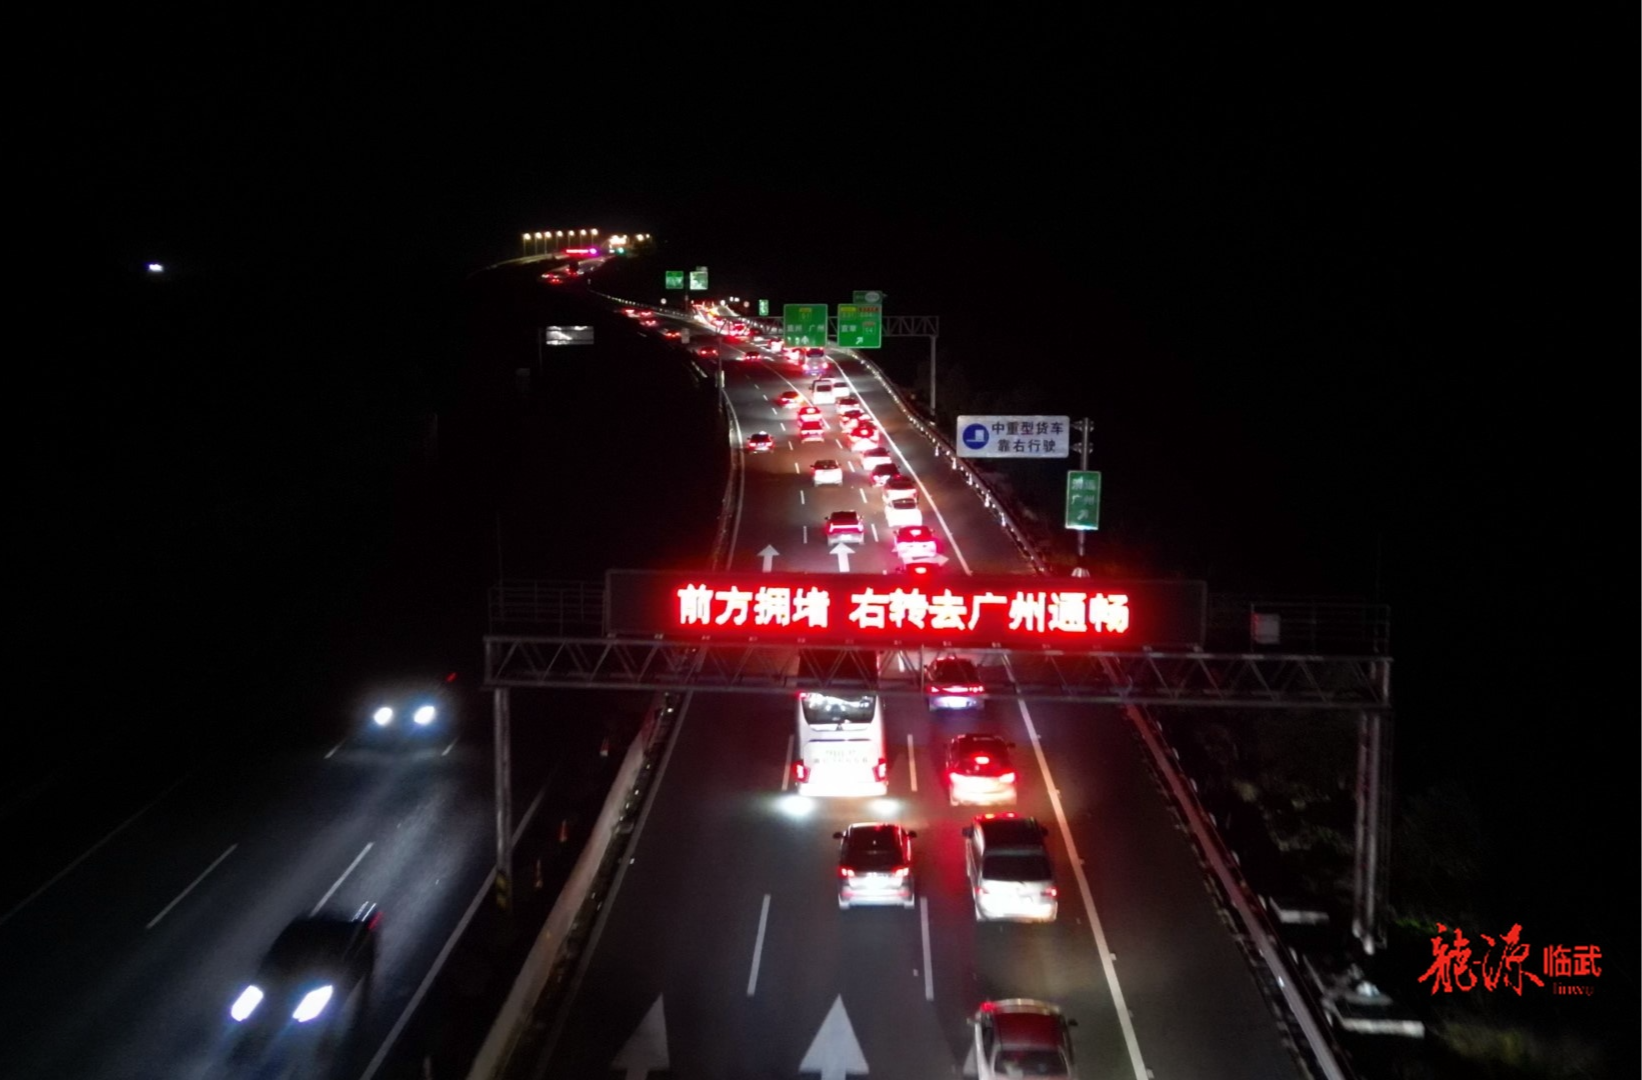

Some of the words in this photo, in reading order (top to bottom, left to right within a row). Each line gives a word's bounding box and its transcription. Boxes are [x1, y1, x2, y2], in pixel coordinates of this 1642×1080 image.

[991, 421, 1064, 436] 中重型货车
[997, 439, 1056, 453] 靠右行驶
[677, 584, 831, 628] 前方拥堵
[848, 587, 1130, 632] 右转去广州通畅
